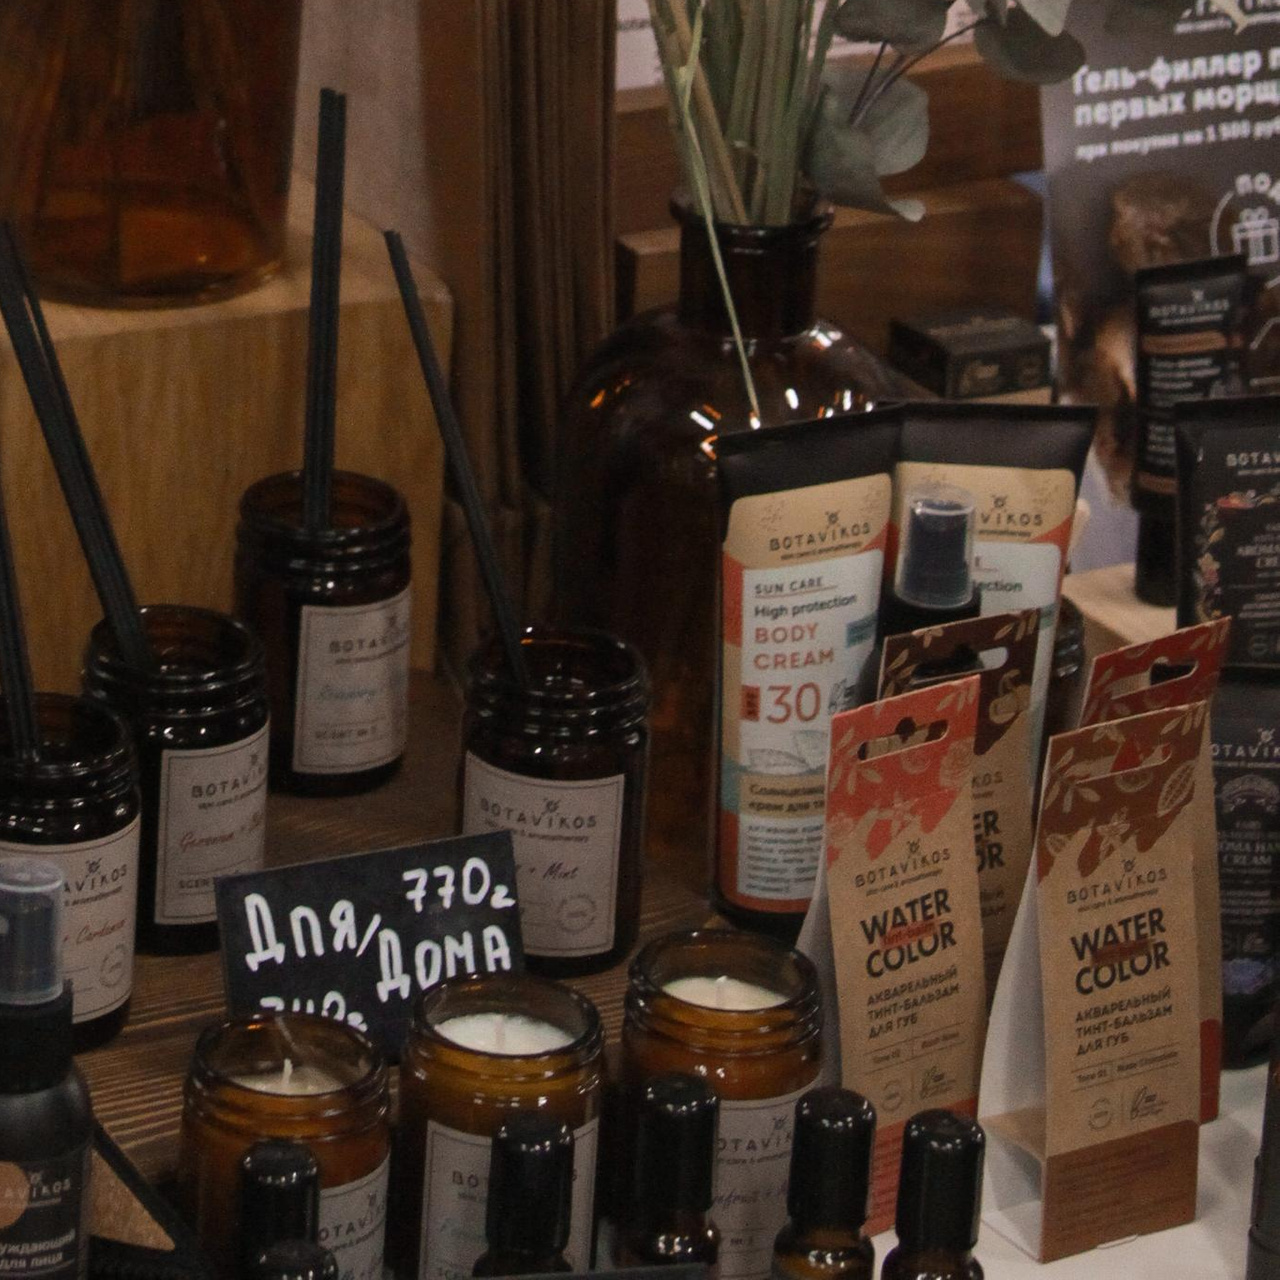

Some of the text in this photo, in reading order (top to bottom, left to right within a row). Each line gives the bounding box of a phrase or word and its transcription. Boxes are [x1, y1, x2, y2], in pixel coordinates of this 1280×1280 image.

[1072, 50, 1263, 96] Гель-филлер
[1074, 91, 1186, 130] первых
[769, 522, 873, 552] BOTAVIKOS
[754, 577, 824, 595] SUN CARE
[754, 594, 858, 620] High protection
[754, 621, 819, 645] BODY
[753, 648, 835, 672] CREAM
[766, 682, 822, 724] 30
[480, 797, 597, 830] BOTAVIKOS
[854, 848, 951, 888] BOTAVIKOS
[1067, 868, 1168, 904] BOTAVIKOS
[859, 887, 952, 946] WATER
[1070, 907, 1167, 961] WATER
[865, 920, 958, 979] COLOR
[1075, 940, 1171, 995] COLOR
[867, 965, 958, 1007] АКВАРЕЛЬНЫЙ
[867, 983, 960, 1021] ТИНТ-БАЛЬЗАМ
[1075, 985, 1172, 1022] АКВАРЕЛЬНЫЙ
[869, 1011, 919, 1040] ДЛЯ ГУБ
[1076, 1004, 1173, 1039] ТИНТ-БАЛЬЗАМ
[1076, 1032, 1130, 1056] ДЛЯ ГУБ
